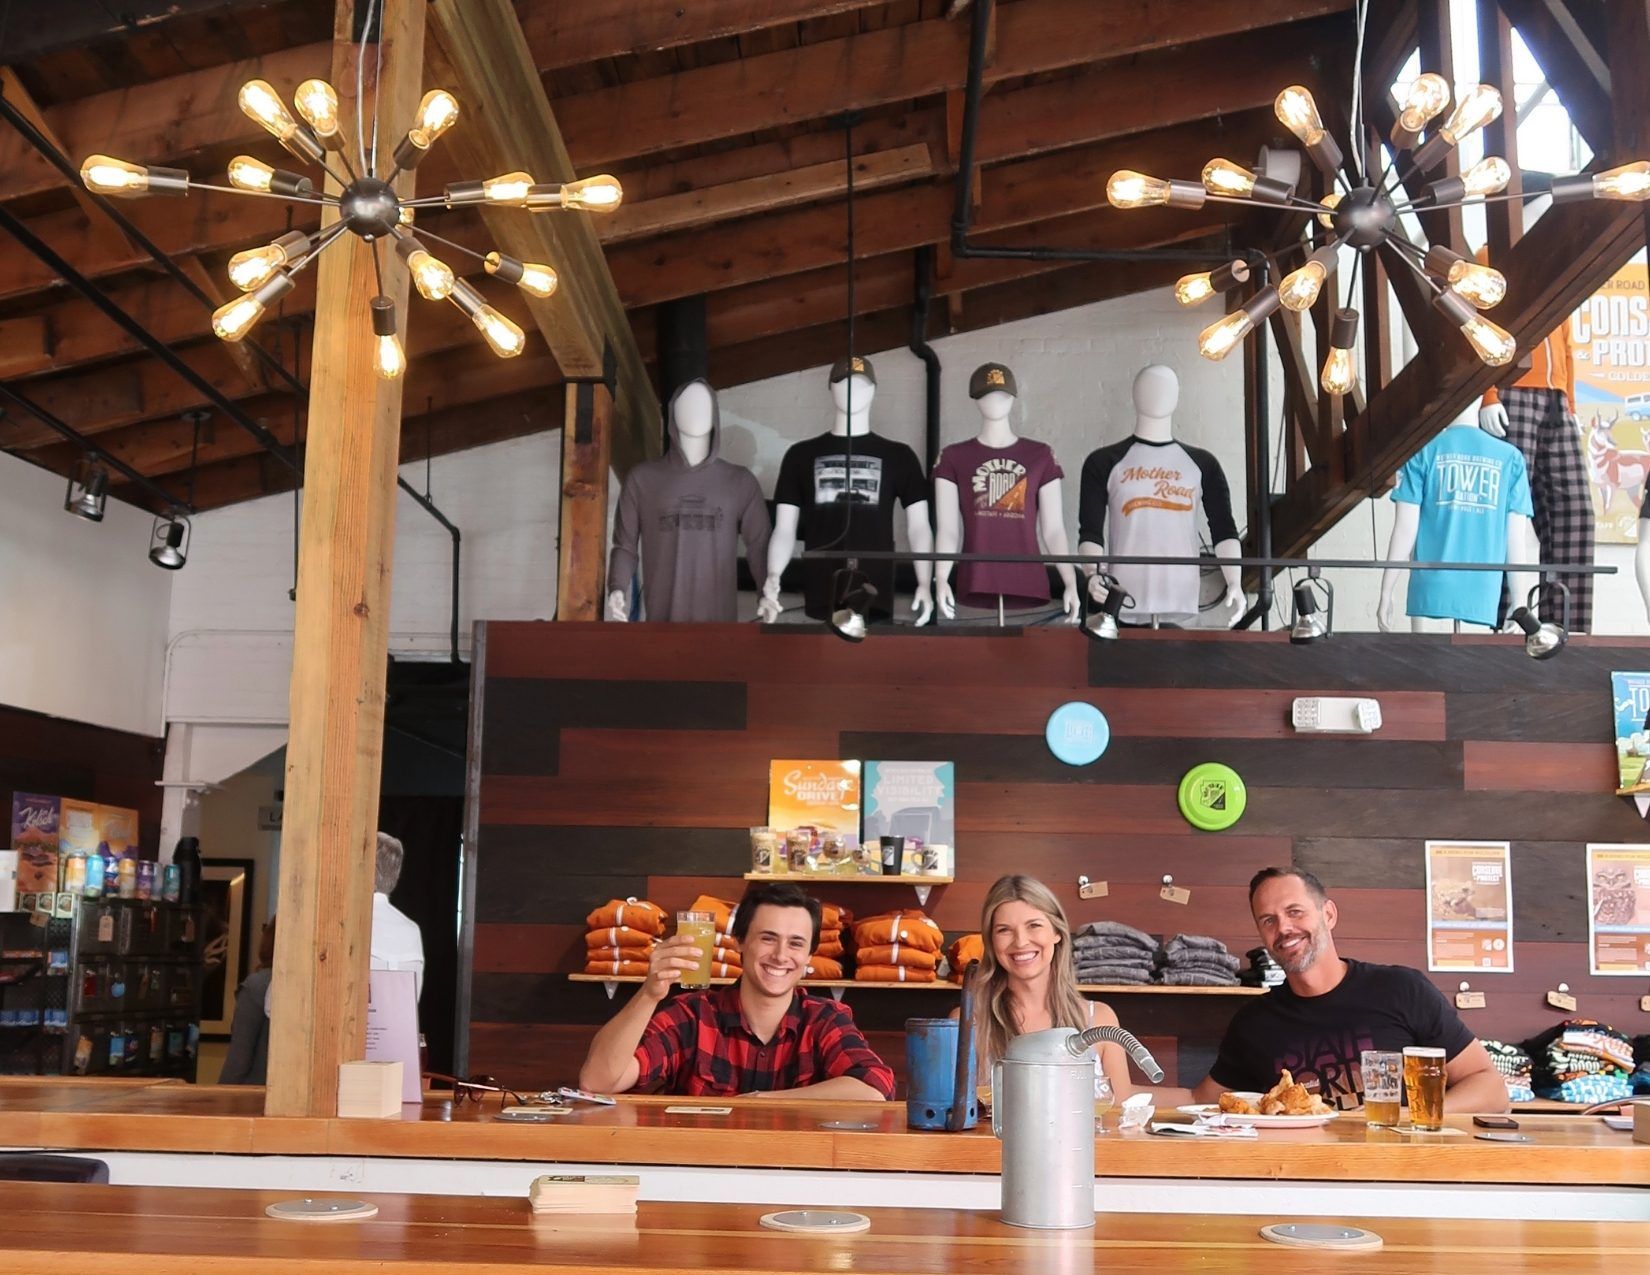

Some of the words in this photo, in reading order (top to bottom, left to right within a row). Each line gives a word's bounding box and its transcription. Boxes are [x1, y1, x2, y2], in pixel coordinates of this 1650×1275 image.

[1616, 280, 1646, 290] ROAD
[1572, 295, 1650, 344] CONS
[1592, 340, 1650, 367] PRO
[971, 458, 1027, 493] MOTHER
[989, 472, 1016, 507] ROAD
[1120, 465, 1183, 484] Mother
[1153, 480, 1196, 499] Road
[1436, 463, 1501, 506] TOWER
